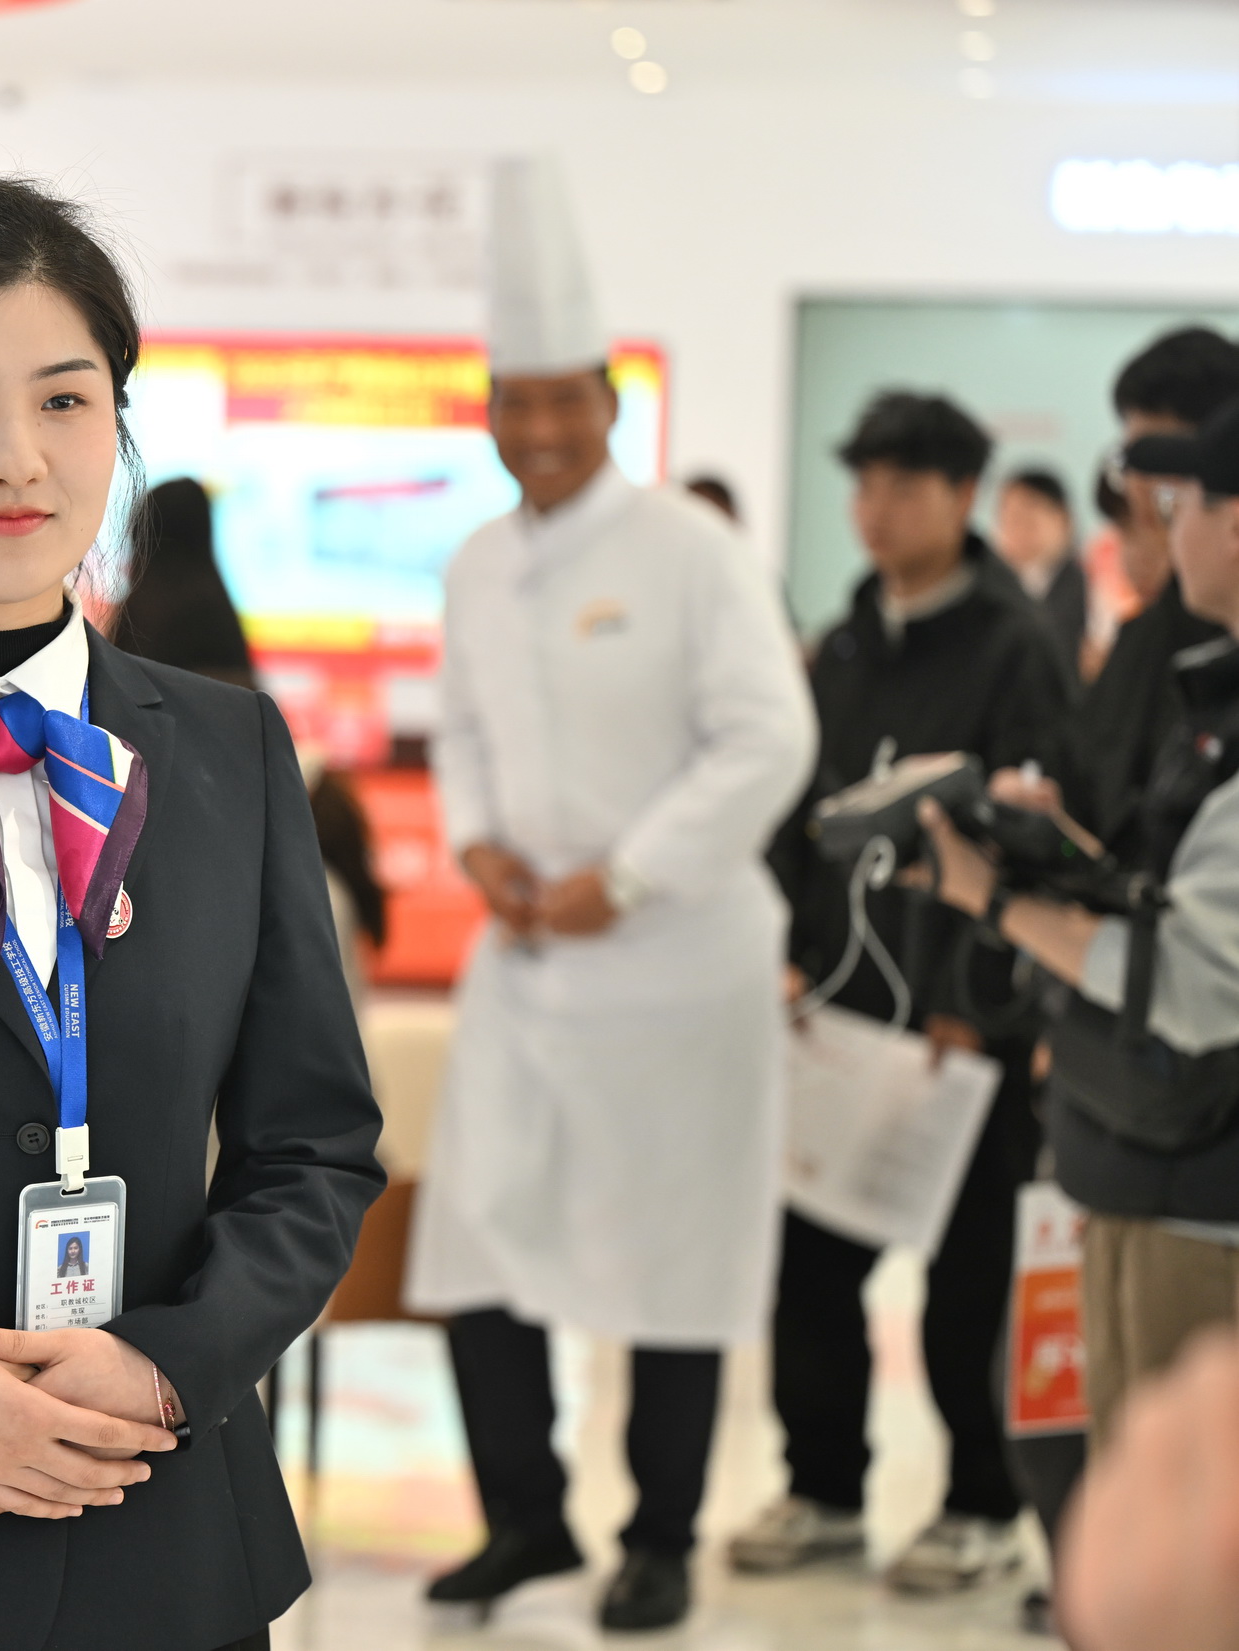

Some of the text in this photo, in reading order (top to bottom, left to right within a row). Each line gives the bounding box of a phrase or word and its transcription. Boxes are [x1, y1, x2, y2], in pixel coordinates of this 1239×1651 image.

[12, 939, 23, 957] SCHOOL
[21, 958, 34, 982] TECHNICAL
[2, 942, 53, 1041] 安徽新东方高级技工学校
[32, 983, 42, 1001] SENIOR
[40, 1000, 48, 1011] EAST
[70, 984, 79, 1037] NEW EAST
[50, 1279, 95, 1295] 工作证
[61, 1296, 96, 1306] 职教城校区
[67, 1317, 88, 1325] 市场部
